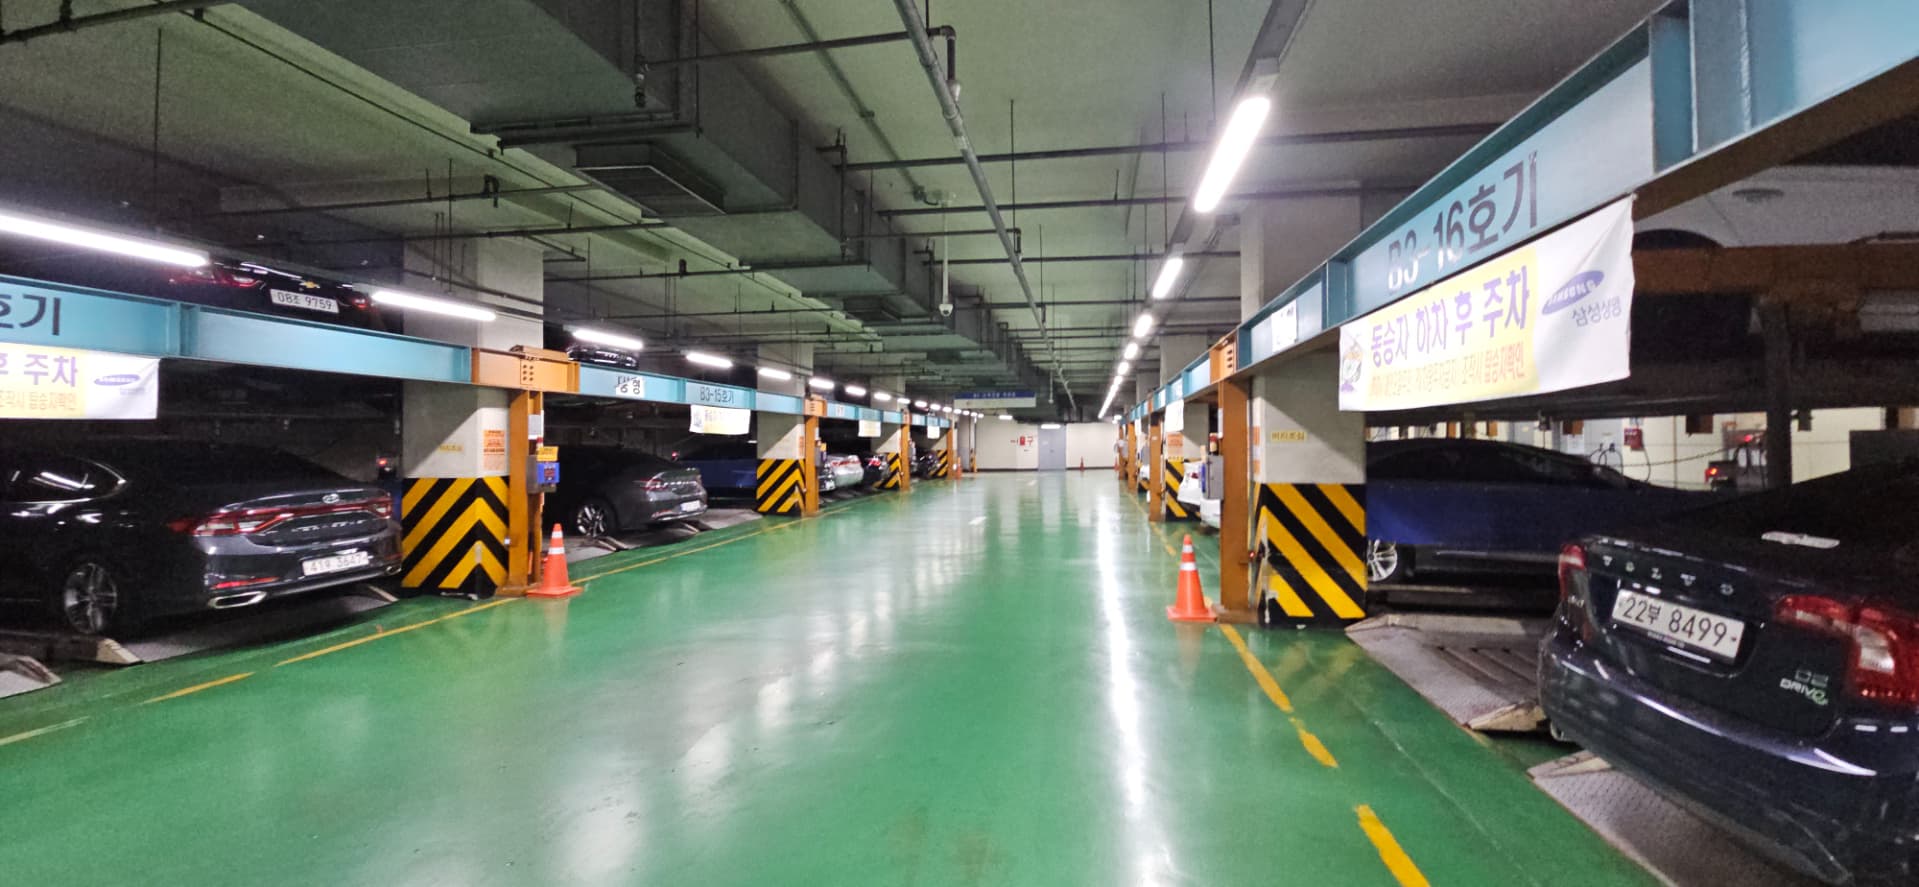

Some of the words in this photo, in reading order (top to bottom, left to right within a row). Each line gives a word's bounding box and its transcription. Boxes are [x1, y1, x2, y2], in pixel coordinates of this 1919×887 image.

[1388, 150, 1538, 294] B3-16호기
[1371, 313, 1410, 368] 동승자
[1415, 299, 1449, 354] 하차
[1454, 290, 1474, 346] 후
[1483, 265, 1530, 338] 주차
[23, 353, 78, 388] 주차
[1622, 597, 1661, 625] 22부
[1668, 609, 1728, 648] 8499
